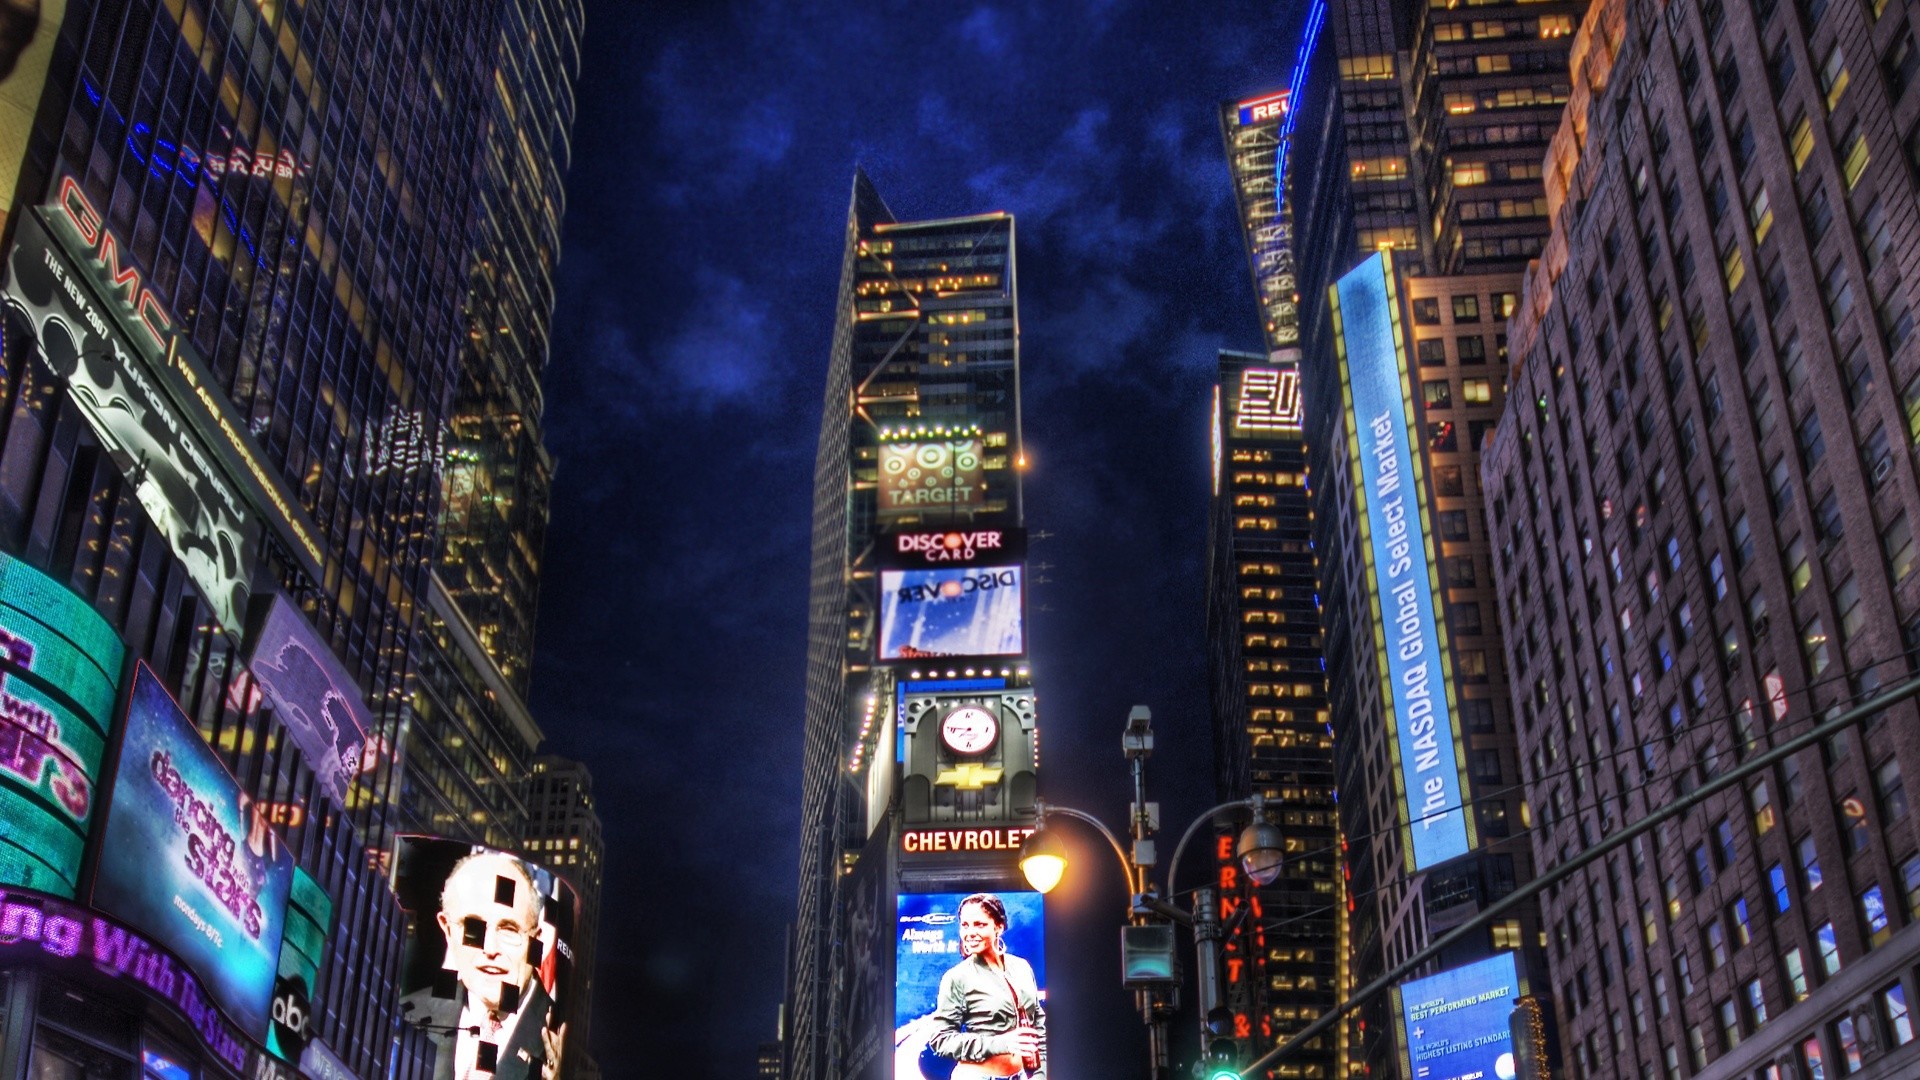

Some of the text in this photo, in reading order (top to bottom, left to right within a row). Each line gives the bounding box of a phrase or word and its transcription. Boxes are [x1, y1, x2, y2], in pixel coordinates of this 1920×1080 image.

[60, 175, 171, 351] GMC
[43, 248, 245, 524] THE NEW 2007 YUKON DENALI
[177, 356, 323, 567] WE ARE PROFESSIONAL GRADE
[888, 486, 973, 505] TARGET
[898, 532, 1001, 551] DISCOVER
[926, 549, 976, 561] CARD
[1370, 409, 1448, 830] The NASDAQ Global Select Market
[0, 889, 83, 958] ng
[92, 917, 175, 998] With
[1217, 836, 1243, 983] ERNT
[1410, 986, 1510, 1021] BEST PERFORMING MARKET
[1416, 1048, 1444, 1061] HIGHEST
[1446, 1040, 1473, 1054] LISTING
